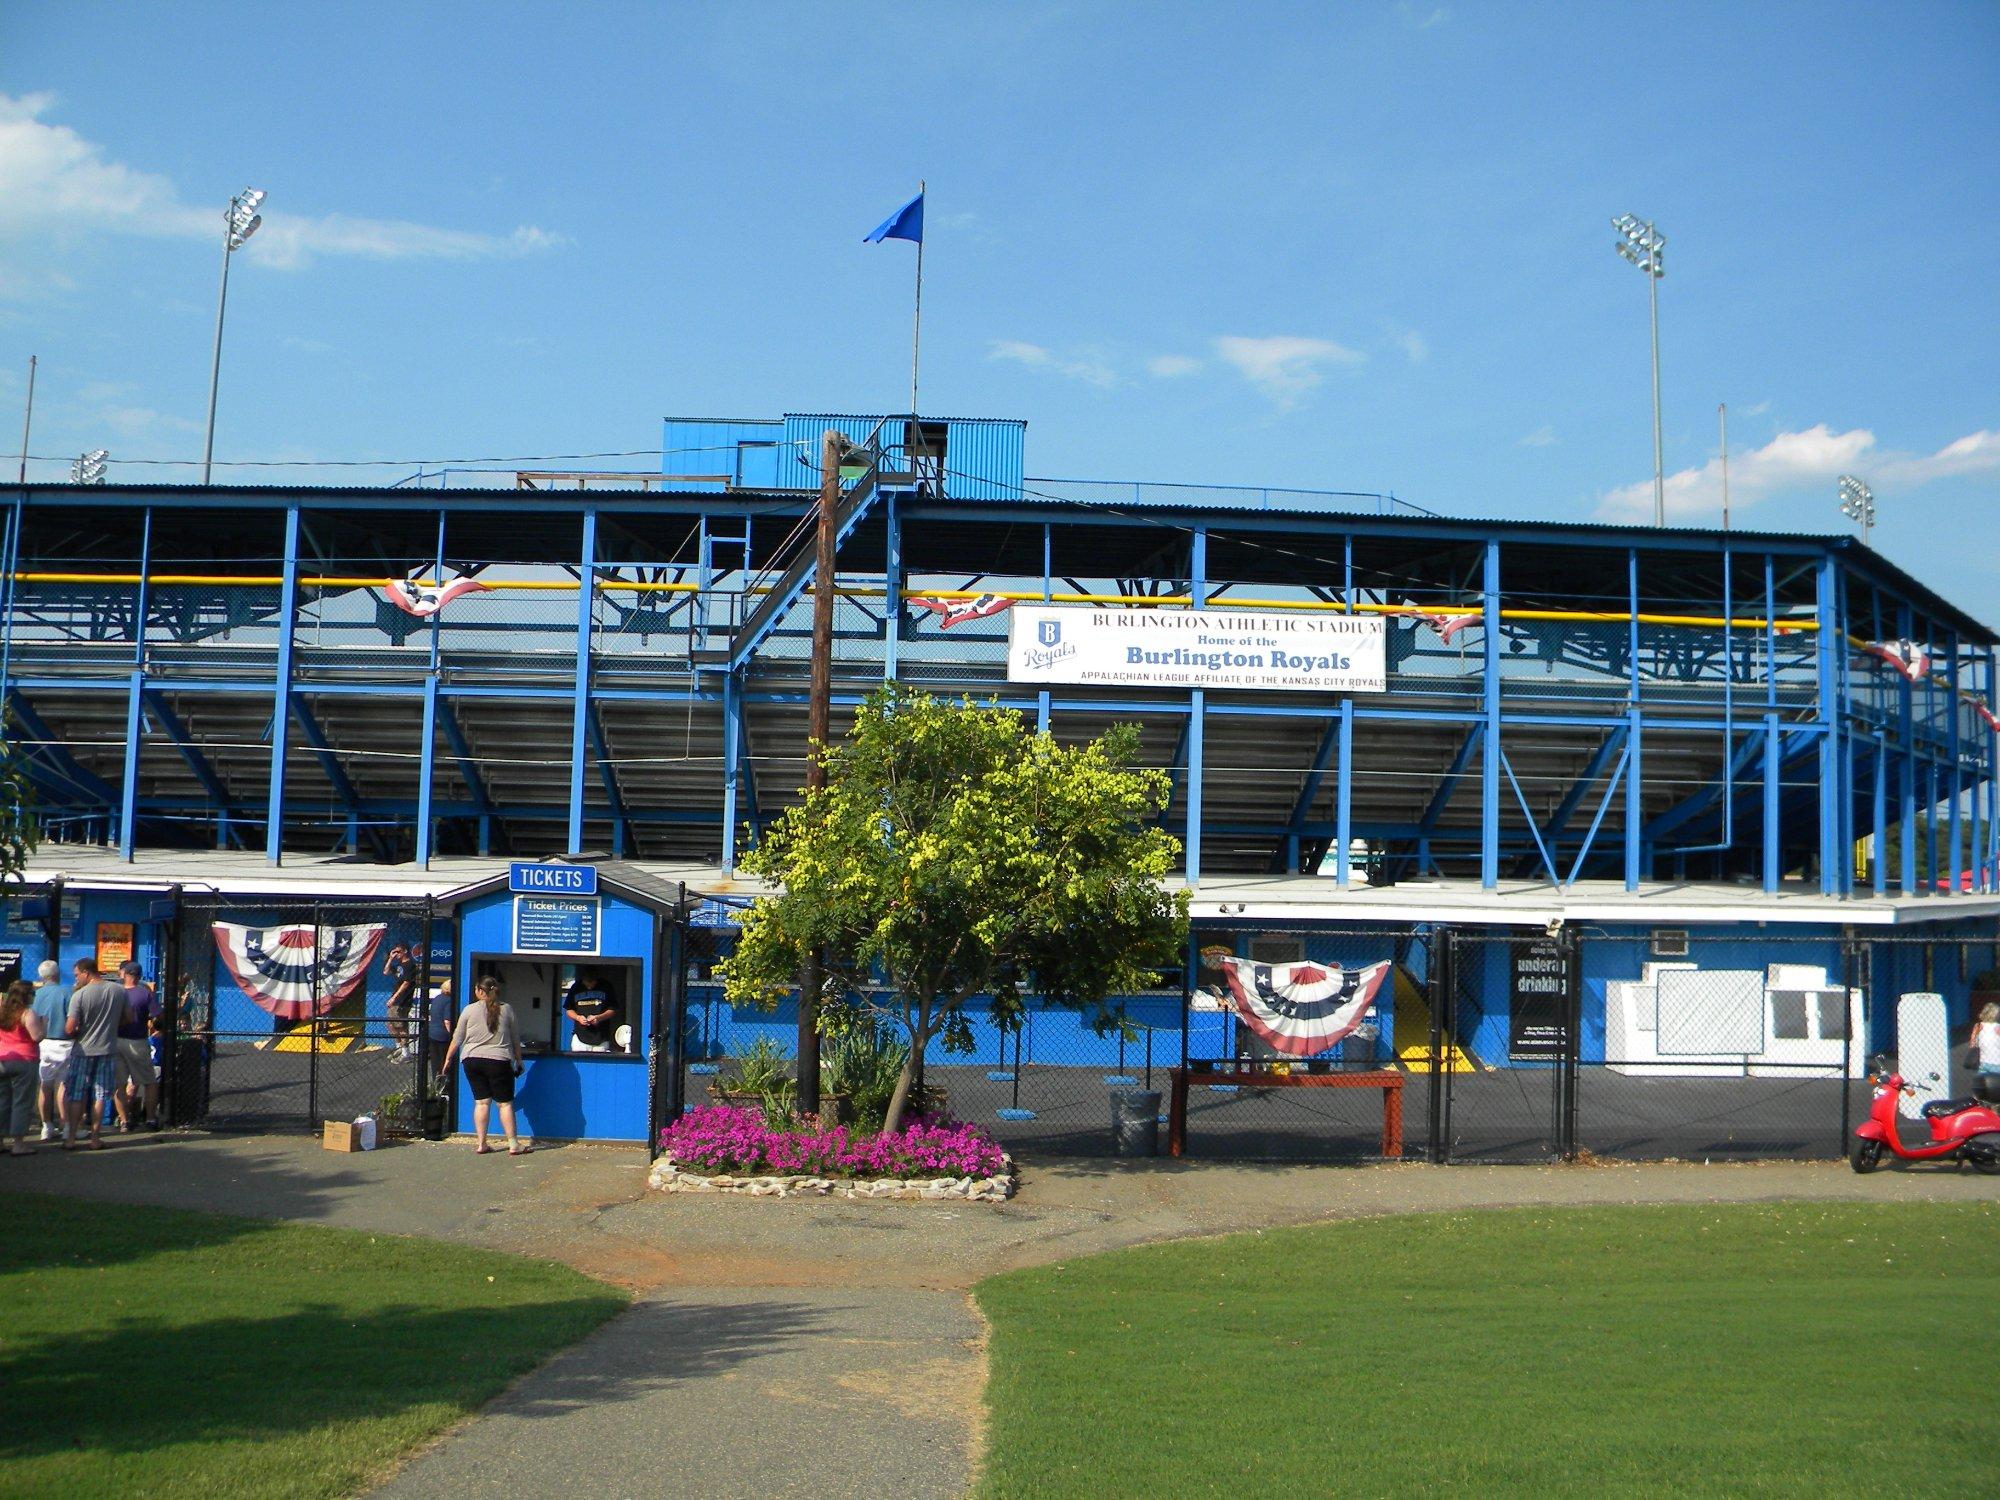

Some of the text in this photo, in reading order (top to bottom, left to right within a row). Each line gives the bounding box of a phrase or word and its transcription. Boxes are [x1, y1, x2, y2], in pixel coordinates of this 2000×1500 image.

[1044, 623, 1056, 643] B
[1093, 613, 1383, 635] BURLINGTON ATHLETIC STADIUM
[1198, 635, 1278, 647] Home of the
[1024, 641, 1077, 670] Royals
[1126, 646, 1351, 673] Burlington Royals
[1081, 671, 1386, 688] APPALACHIAN LEAGUE AFFILIATE OF THE KANSAS CITY ROYALS
[520, 868, 582, 888] TICKETS
[527, 900, 588, 912] Ticket Prices
